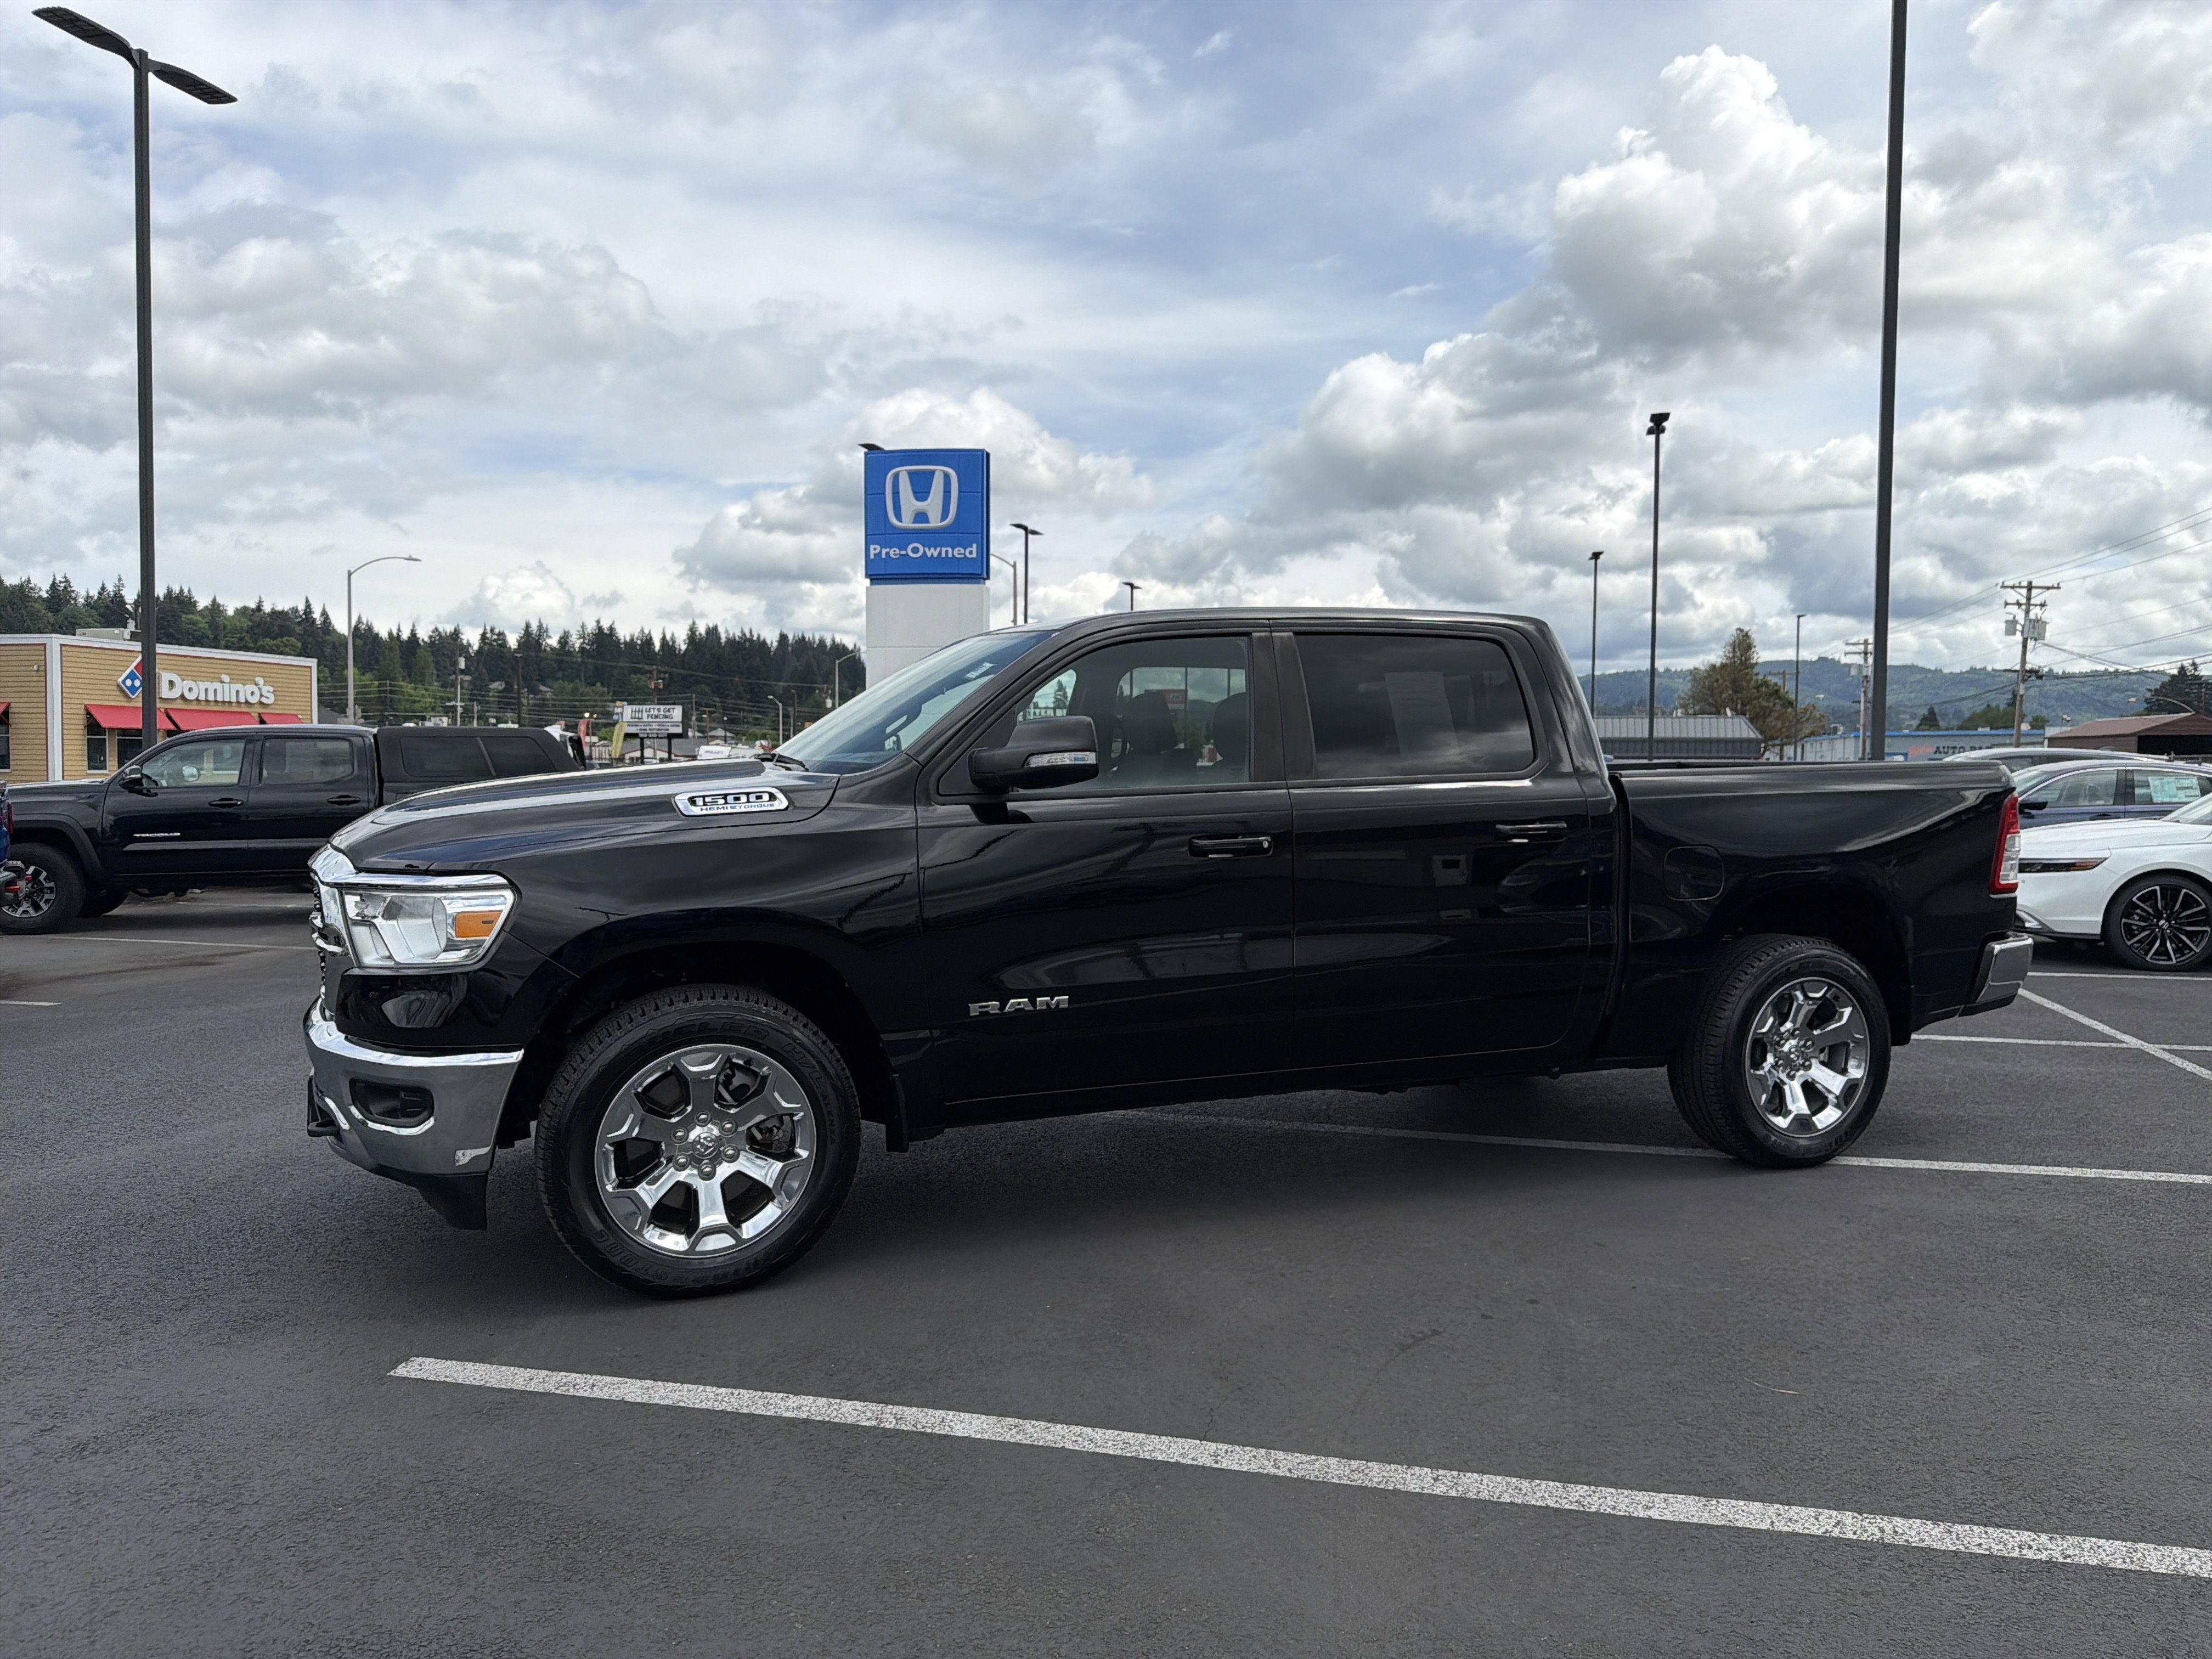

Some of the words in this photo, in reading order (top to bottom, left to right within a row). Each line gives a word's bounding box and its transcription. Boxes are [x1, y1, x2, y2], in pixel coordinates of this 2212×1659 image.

[870, 543, 977, 559] Pre-Owned
[160, 672, 275, 704] Domino's
[1933, 746, 1966, 755] AUTO
[693, 793, 769, 806] 1500
[968, 996, 1069, 1016] RAM
